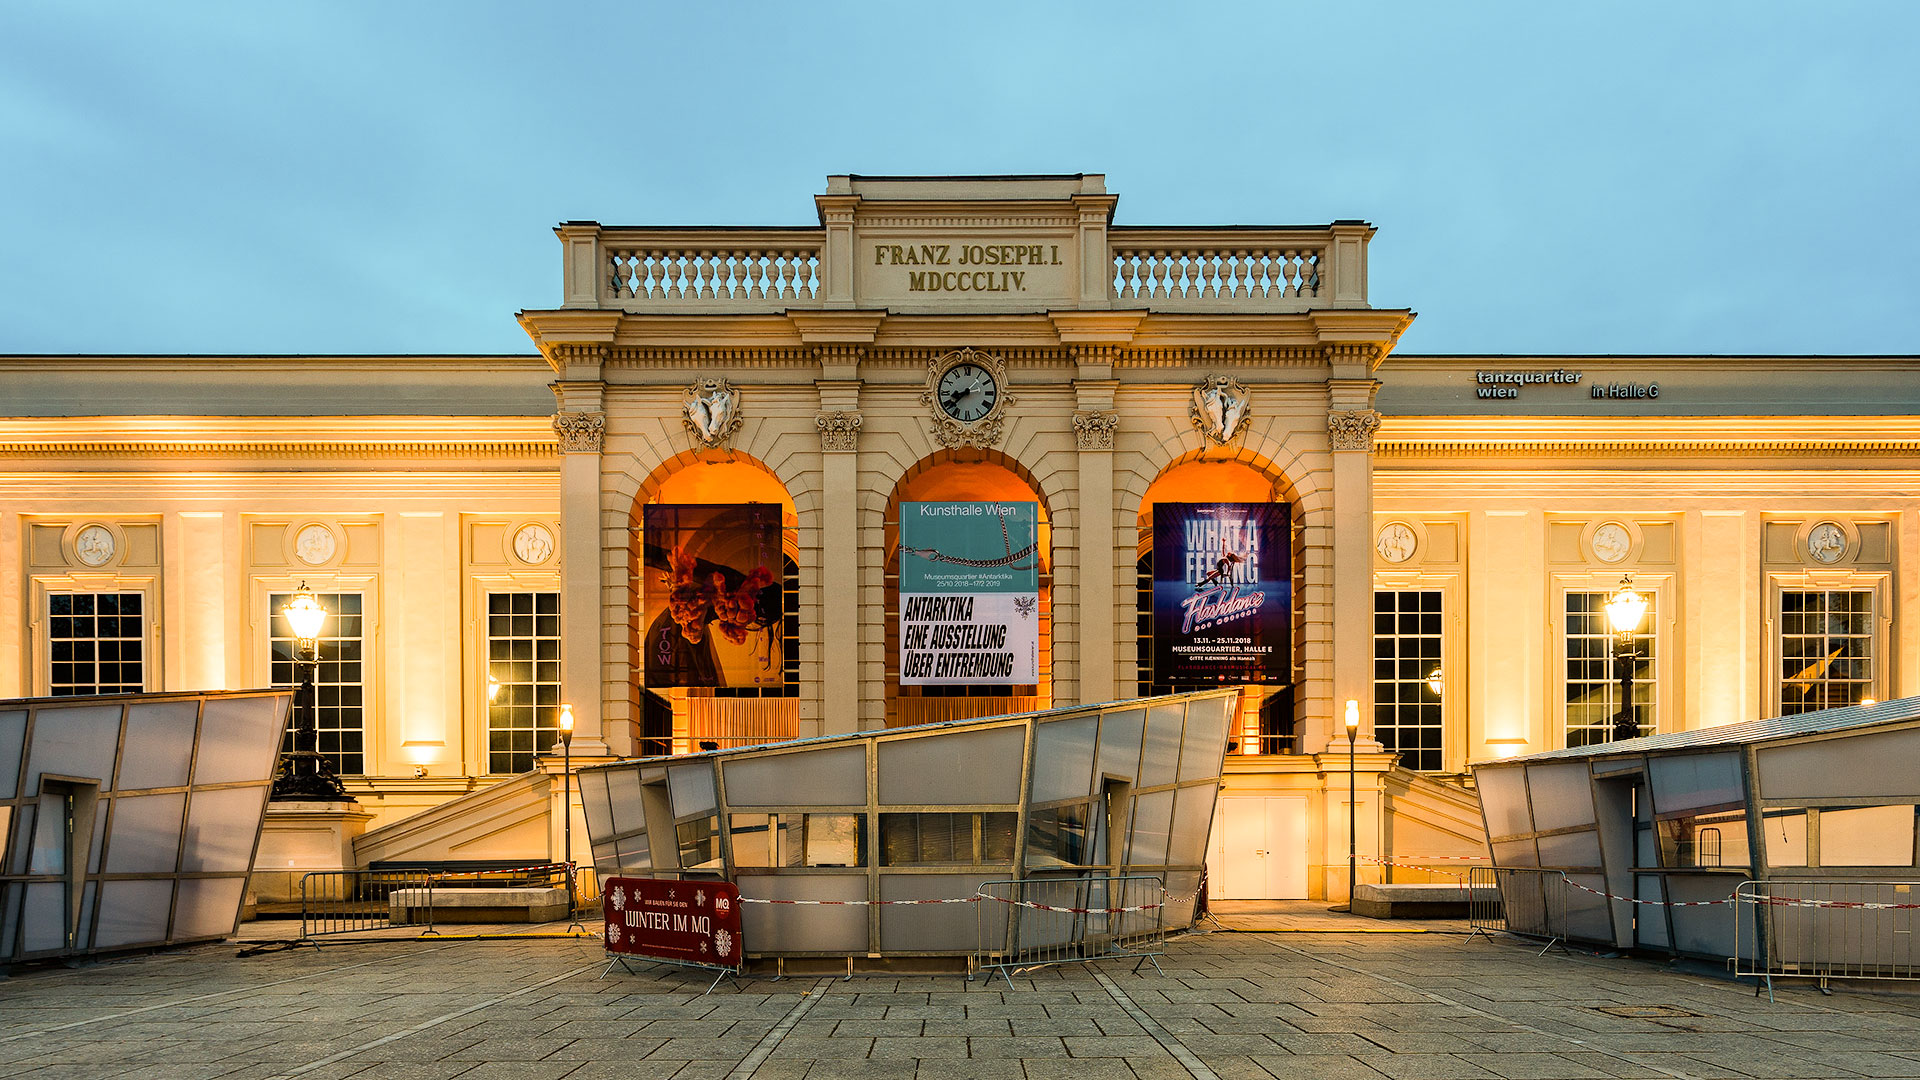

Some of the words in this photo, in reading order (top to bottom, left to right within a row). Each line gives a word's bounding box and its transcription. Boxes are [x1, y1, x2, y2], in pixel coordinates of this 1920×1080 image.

[874, 245, 951, 265] FRANZ
[958, 245, 1048, 265] JOSEPH.
[1050, 245, 1063, 265] I.
[908, 271, 1026, 292] MDCCCLIV.
[1477, 370, 1582, 385] tanzquartier
[1477, 385, 1518, 398] wien
[1592, 384, 1605, 398] in
[1608, 384, 1645, 398] Halle
[1648, 384, 1659, 398] G
[920, 504, 982, 517] Kunsthalle
[985, 504, 1016, 517] Wien
[1186, 520, 1242, 551] WHAT
[1246, 520, 1258, 551] A
[924, 573, 977, 581] Museumsquartier
[904, 597, 974, 621] ANTARKTIKA
[1181, 586, 1265, 634] Flashdance
[904, 625, 930, 649] EINE
[930, 625, 1007, 649] AUSSTELLUNG
[903, 650, 934, 678] ÜBER
[934, 652, 1014, 678] ENTFREMDUNG
[715, 898, 730, 910] MQ
[625, 910, 670, 930] WINTER
[673, 914, 687, 932] IM
[691, 915, 711, 938] MQ
